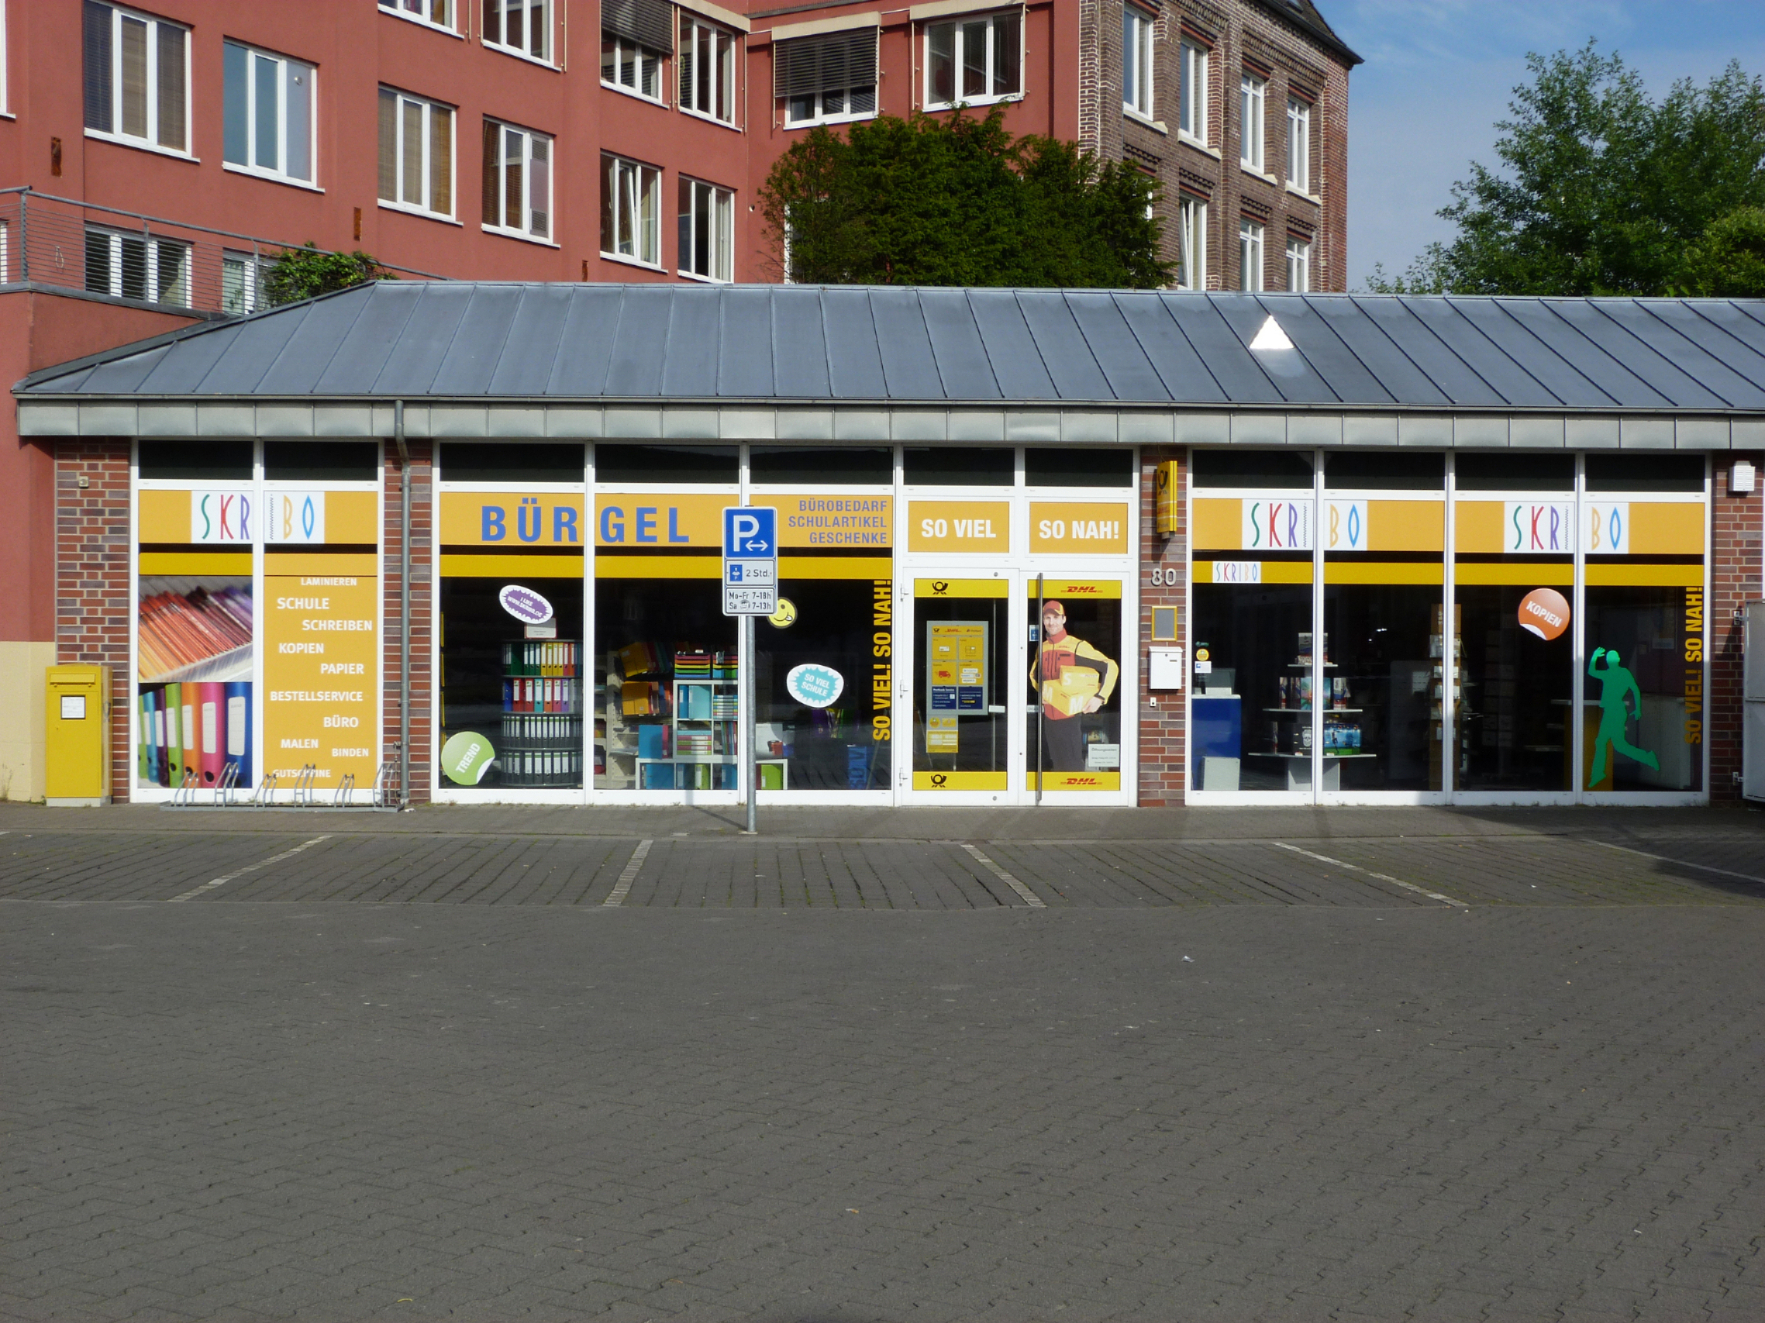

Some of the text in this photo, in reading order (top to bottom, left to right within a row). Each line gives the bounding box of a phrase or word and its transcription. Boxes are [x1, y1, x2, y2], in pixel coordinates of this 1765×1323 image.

[799, 497, 887, 512] BÜROBEDARF
[201, 494, 315, 540] SKRIBO
[481, 498, 689, 543] BÜRGEL
[788, 516, 887, 528] SCHULARTIKEL
[921, 518, 996, 538] SO VIEL
[1039, 520, 1119, 539] SO NAH!
[1251, 502, 1360, 548] SKRIBO
[1513, 505, 1621, 551] SKRIBO
[733, 515, 760, 552] P
[809, 532, 887, 544] GESCHENKE
[746, 568, 770, 578] 2 Std.
[1151, 568, 1177, 586] 80
[1216, 562, 1258, 582] SKRIBO
[301, 577, 357, 586] LAMINIEREN
[1066, 585, 1098, 593] DHL
[728, 591, 771, 600] Mo-Fr 7-18h
[277, 597, 330, 610] SCHULE
[729, 602, 771, 610] Sa 7-13h
[1526, 600, 1563, 628] KOPIEN
[302, 619, 373, 631] SCHREIBEN
[278, 643, 325, 654] KOPIEN
[873, 579, 892, 741] SO VIEL! SO NAH!
[1685, 586, 1703, 744] SO VIEL! SO NAH!
[320, 663, 364, 674] PAPIER
[804, 673, 830, 689] SO VIEL
[270, 691, 363, 702] BESTELLSERVICE
[801, 681, 828, 697] SCHULE
[323, 714, 359, 728] BÜRO
[281, 739, 319, 748] MALEN
[332, 748, 369, 757] BINDEN
[455, 742, 481, 774] TREND
